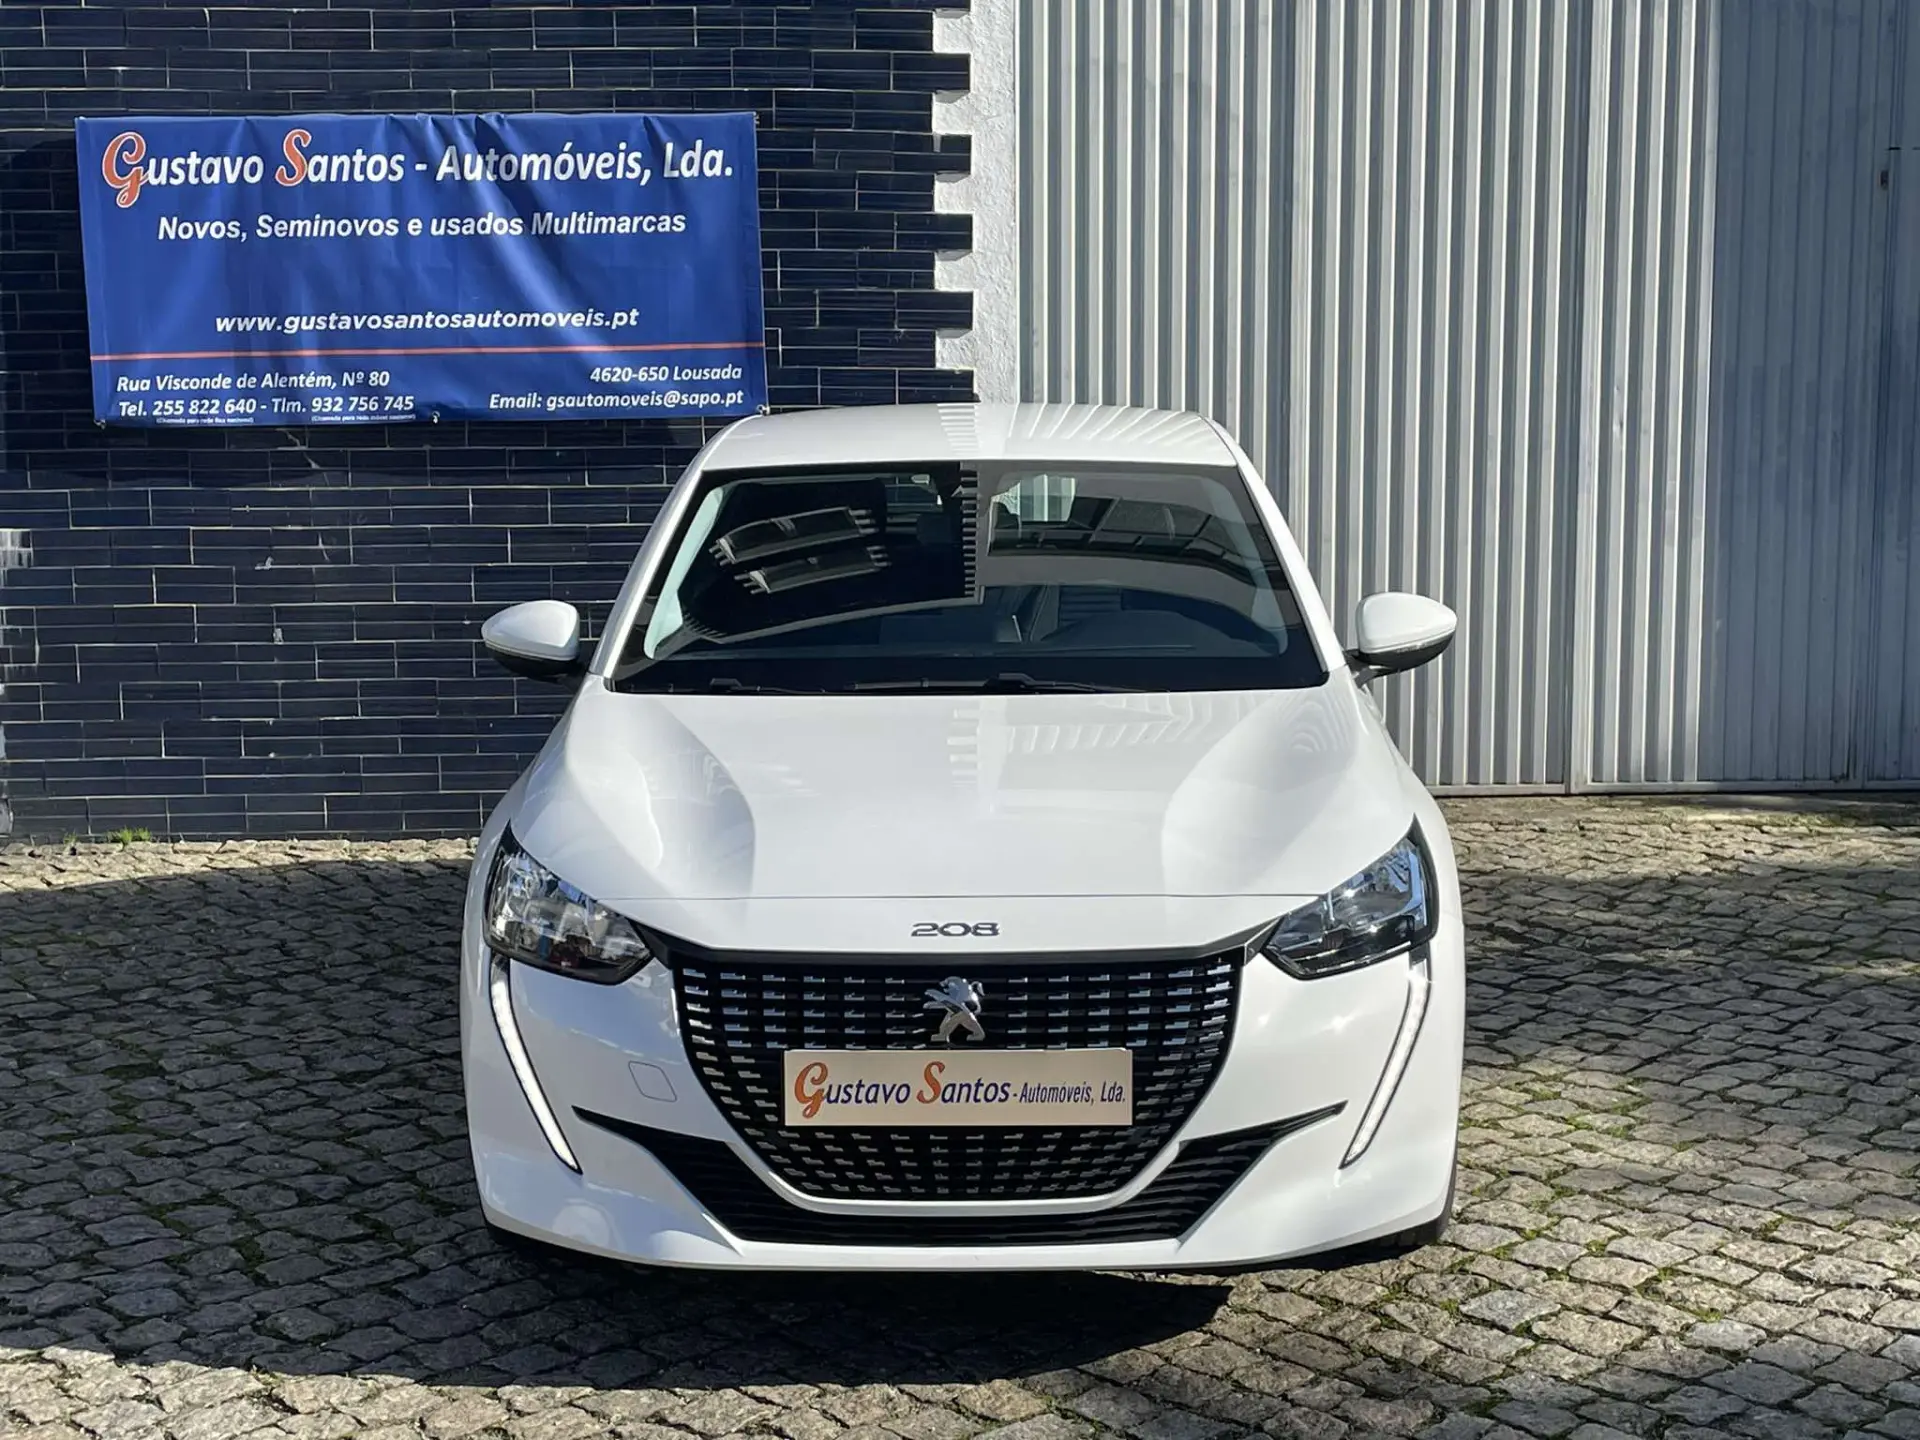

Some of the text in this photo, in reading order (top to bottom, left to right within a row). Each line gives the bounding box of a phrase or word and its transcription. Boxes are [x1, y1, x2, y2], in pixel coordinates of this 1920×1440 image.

[102, 131, 265, 208] Gustavo
[275, 128, 405, 187] Santos
[436, 141, 652, 186] Automóveis,
[663, 139, 733, 179] Lda.
[158, 211, 687, 242] Novos, Seminovos e usados Multimarcas
[215, 308, 639, 334] www.gustavosantosautomoveis.pt
[117, 376, 150, 392] Rua
[156, 374, 231, 391] Visconde
[236, 374, 257, 389] de
[261, 371, 337, 390] Alentém,
[369, 371, 390, 387] 80
[590, 364, 742, 382] 4620-650 Lousada
[119, 400, 148, 417] Tel.
[152, 399, 185, 416] 255
[188, 398, 221, 415] 822
[224, 398, 257, 414] 640
[271, 397, 307, 413] Tlm.
[311, 397, 345, 412] 932
[348, 396, 379, 411] 756
[384, 395, 414, 411] 745
[489, 390, 743, 411] Email: gsautomoveis@sapo.pt
[911, 922, 1001, 937] 208
[794, 1062, 911, 1118] Gustavo
[916, 1061, 1011, 1104] Santos
[1100, 1080, 1126, 1102] Lda.
